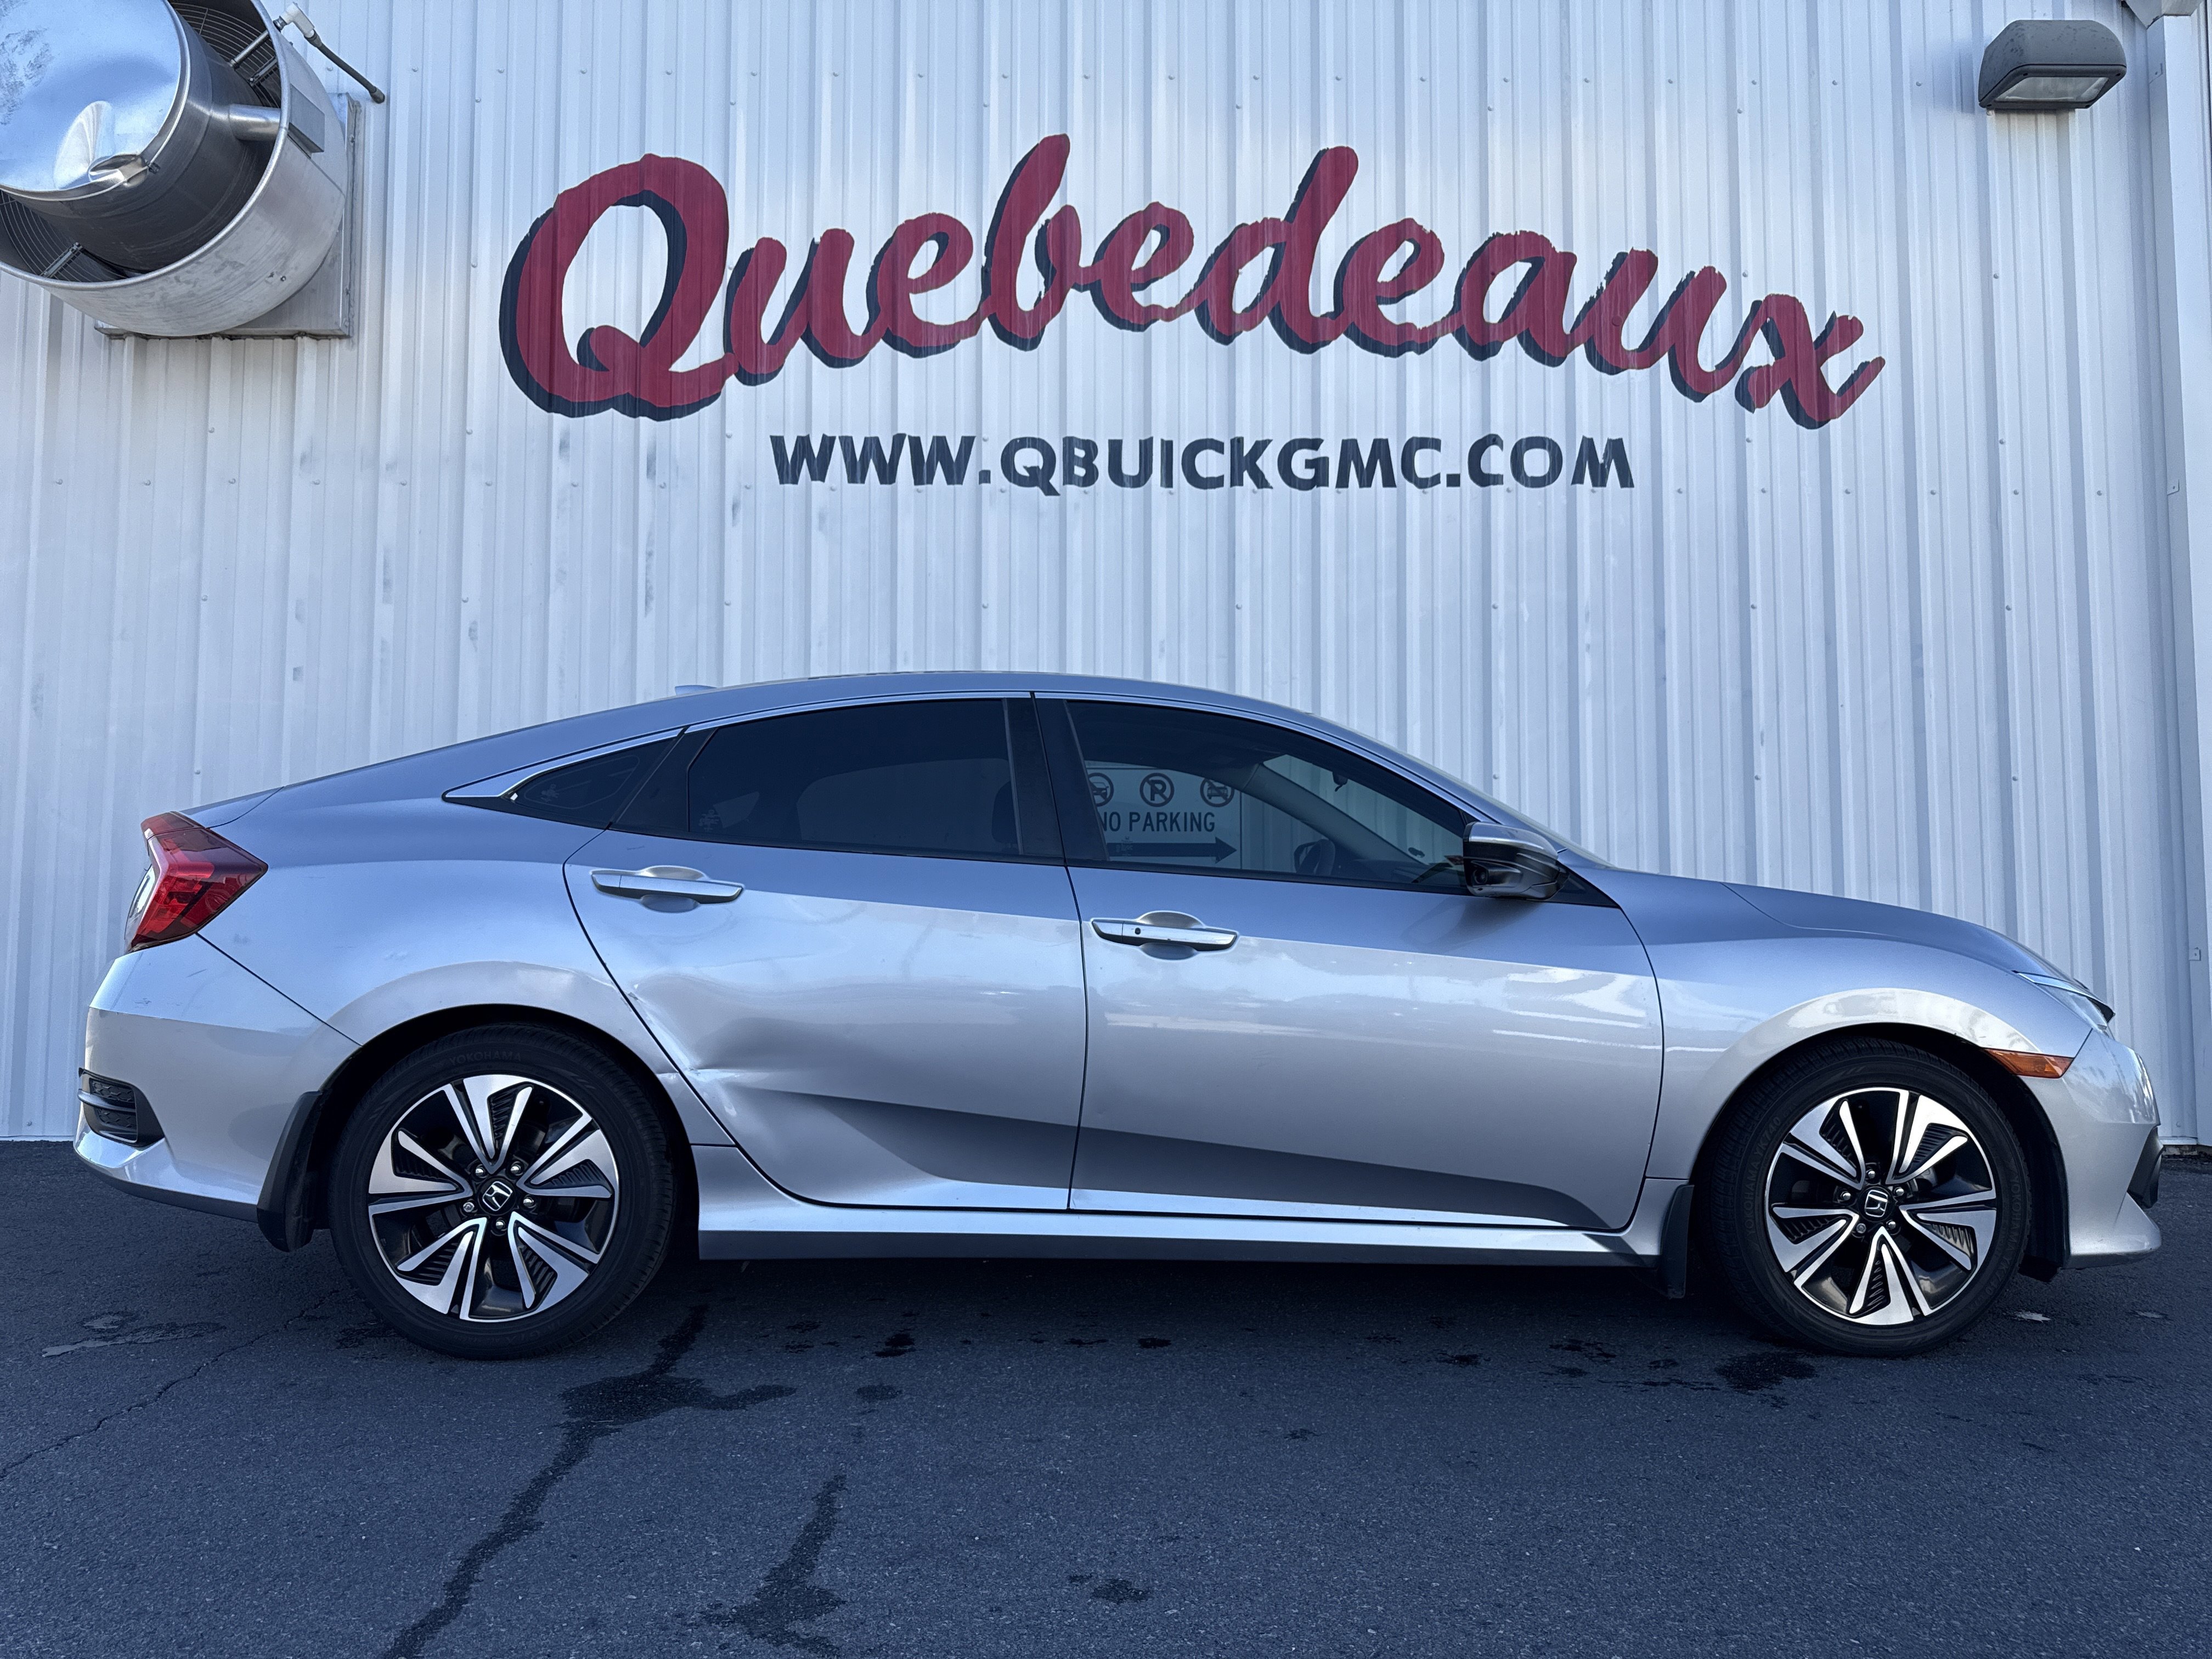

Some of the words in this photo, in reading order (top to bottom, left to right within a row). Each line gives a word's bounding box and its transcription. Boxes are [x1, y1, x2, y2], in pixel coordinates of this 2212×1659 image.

[499, 133, 1886, 430] Quebedeaux
[770, 434, 1635, 496] WWW.QBUICKGMC.COM
[1128, 811, 1216, 832] PARKING
[449, 1050, 522, 1066] YOKOHAMA
[1743, 1160, 1760, 1236] YOKOHAMA
[2007, 1175, 2022, 1252] YOKOHAMA
